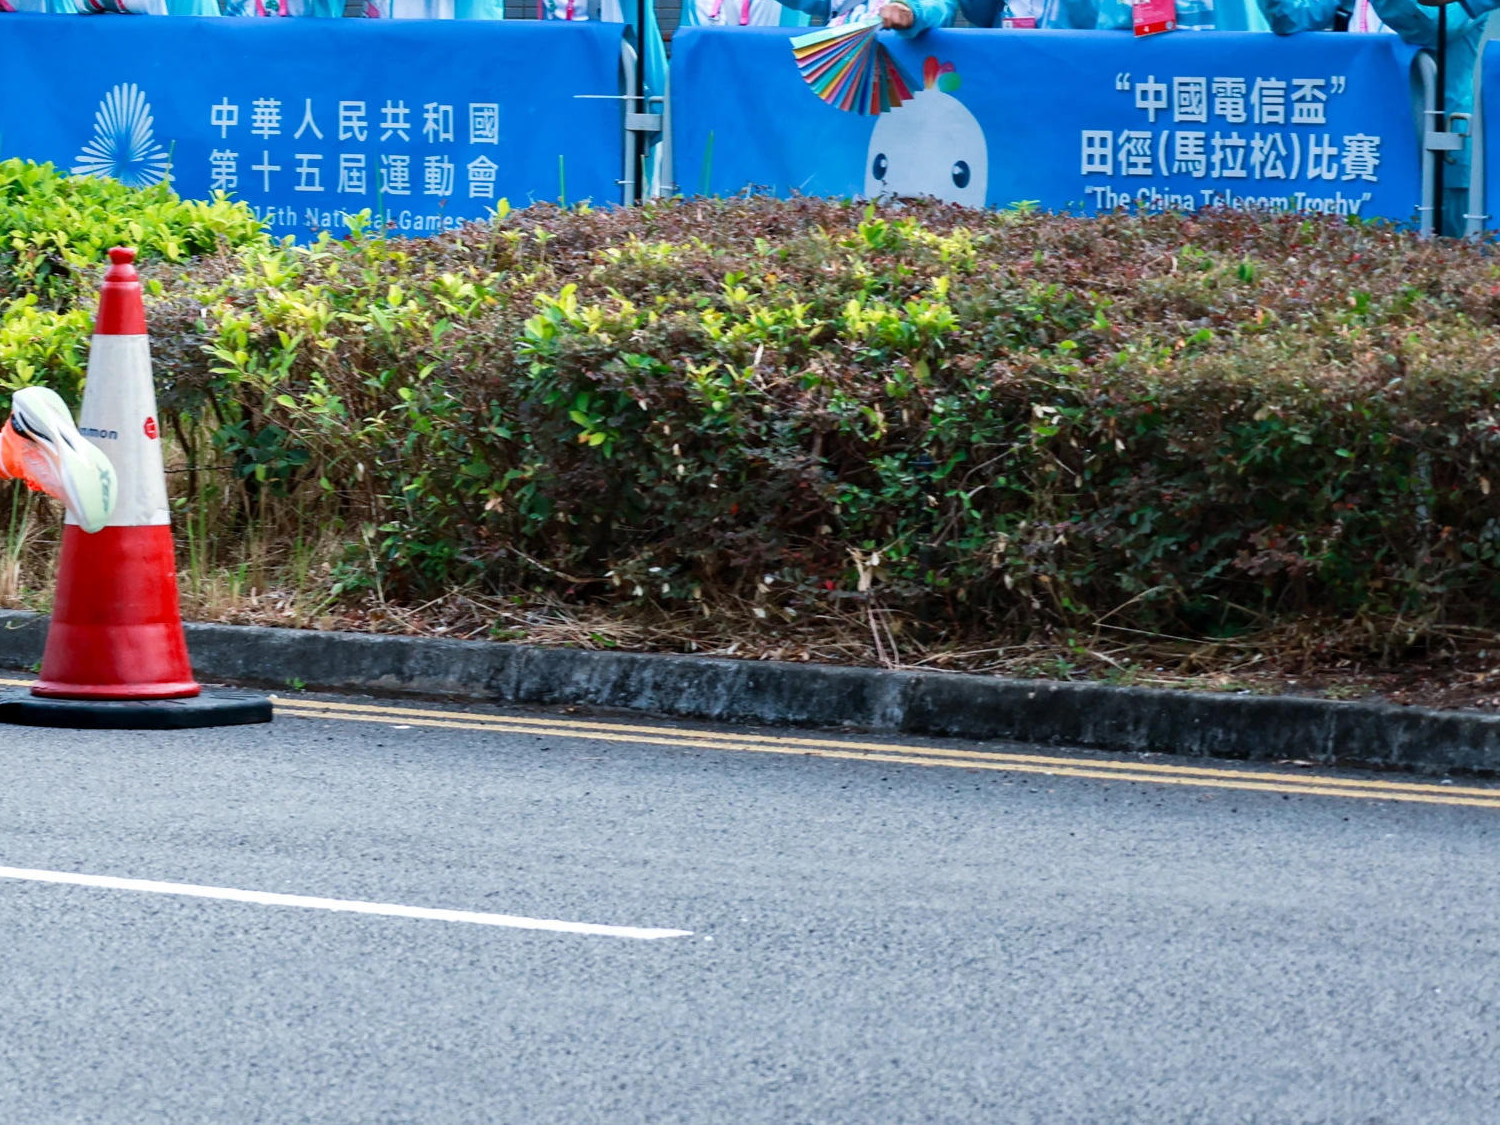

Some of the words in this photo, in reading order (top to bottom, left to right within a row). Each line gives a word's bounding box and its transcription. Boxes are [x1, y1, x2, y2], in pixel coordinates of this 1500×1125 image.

[210, 96, 499, 145] 中華人民共和國
[1115, 72, 1346, 124] “中國電信盃”
[209, 148, 498, 199] 第十五屆運動會
[1080, 129, 1381, 183] 田徑(馬拉松)比賽
